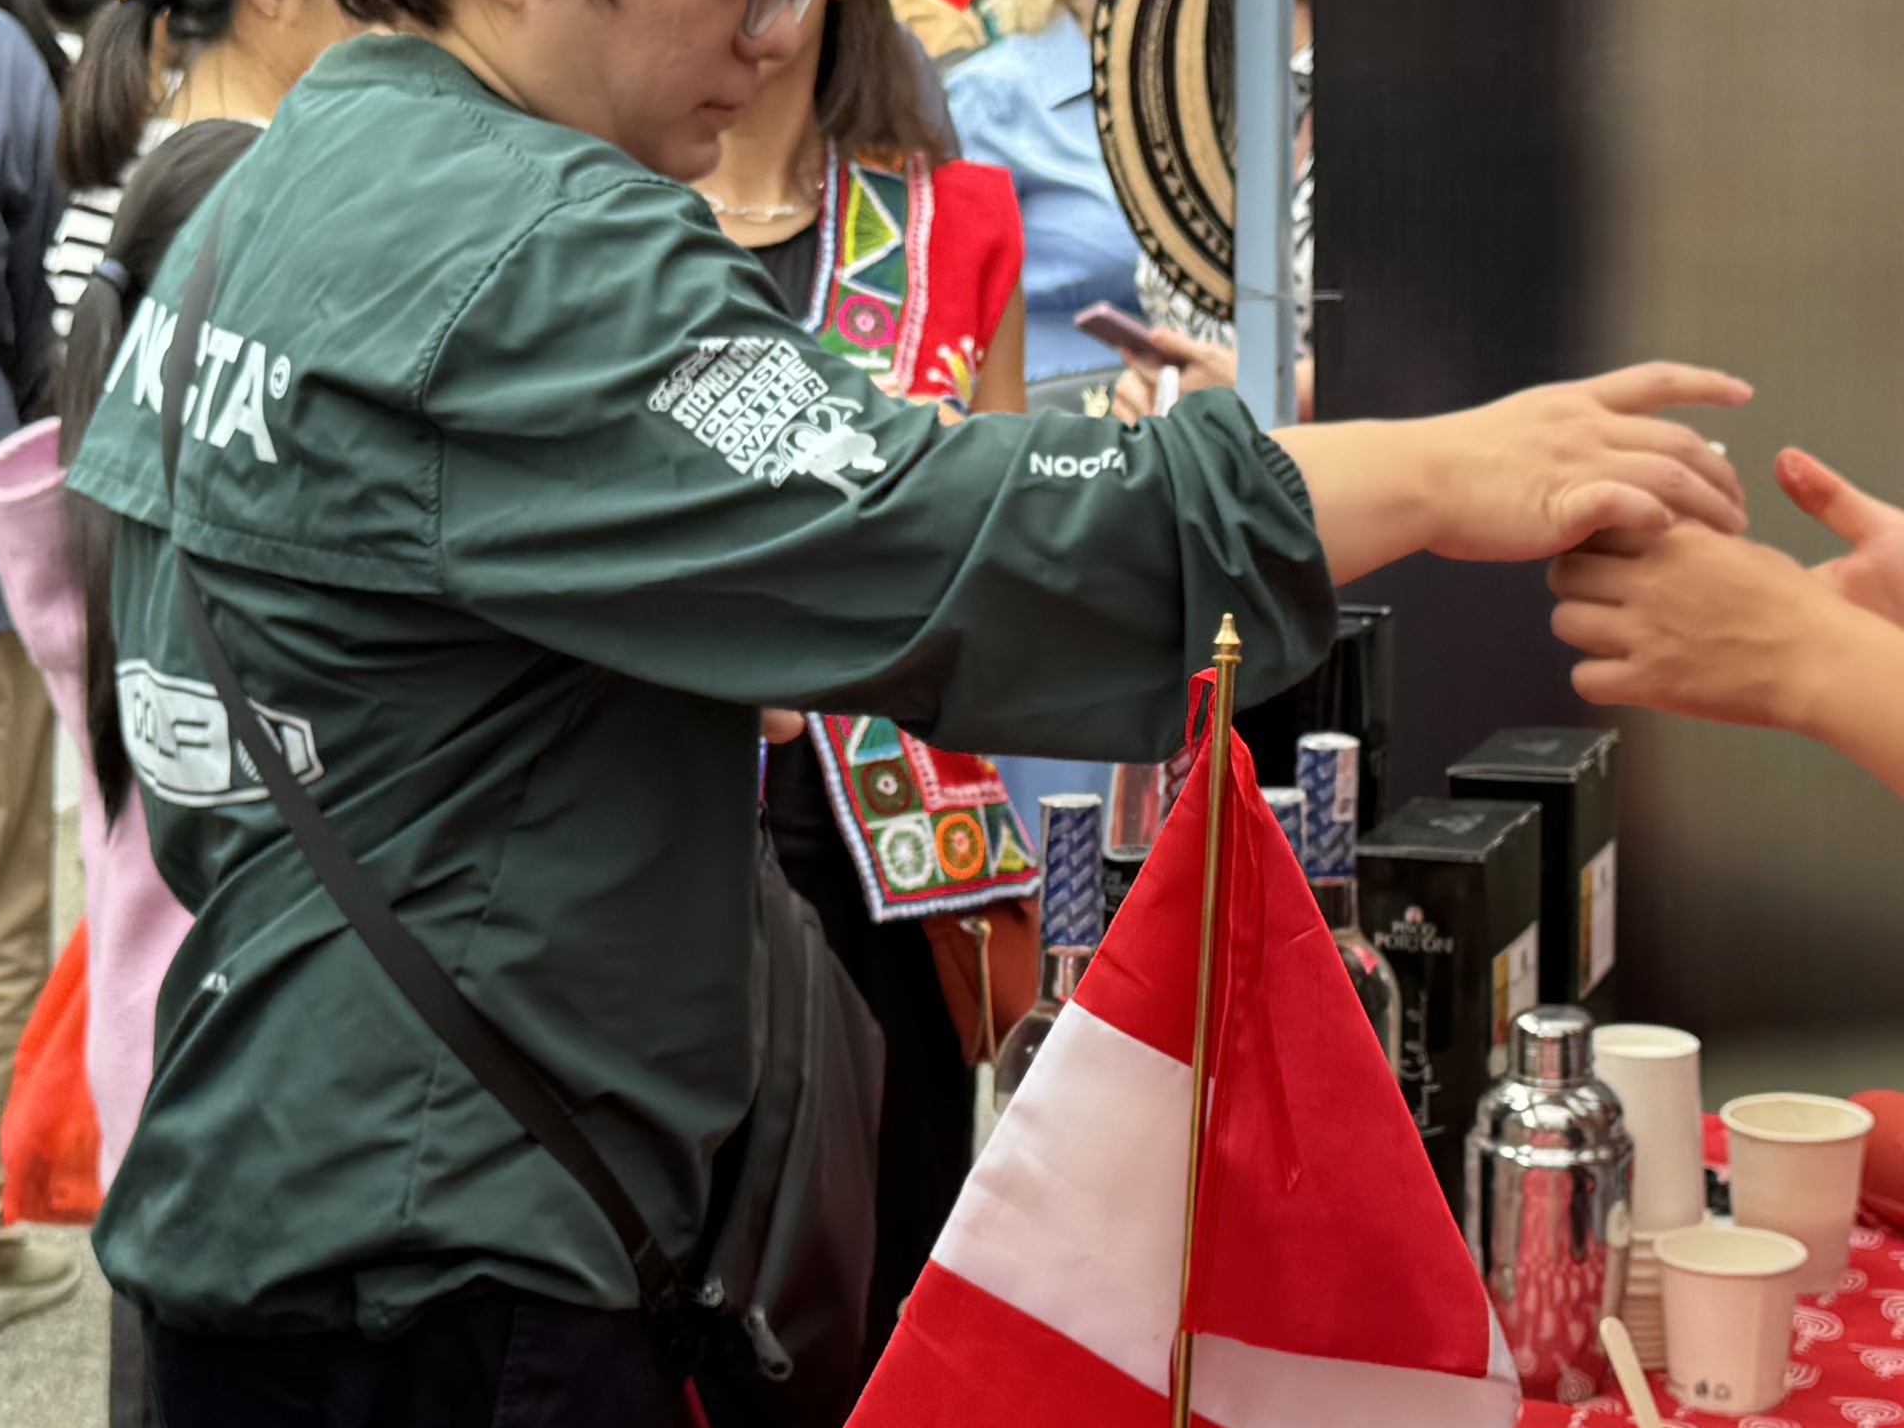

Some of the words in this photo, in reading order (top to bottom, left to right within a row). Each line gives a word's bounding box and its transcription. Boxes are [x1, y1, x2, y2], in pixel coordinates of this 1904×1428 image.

[701, 344, 794, 440] CLASH
[732, 376, 826, 465] WATER
[1029, 448, 1127, 479] NOCTA
